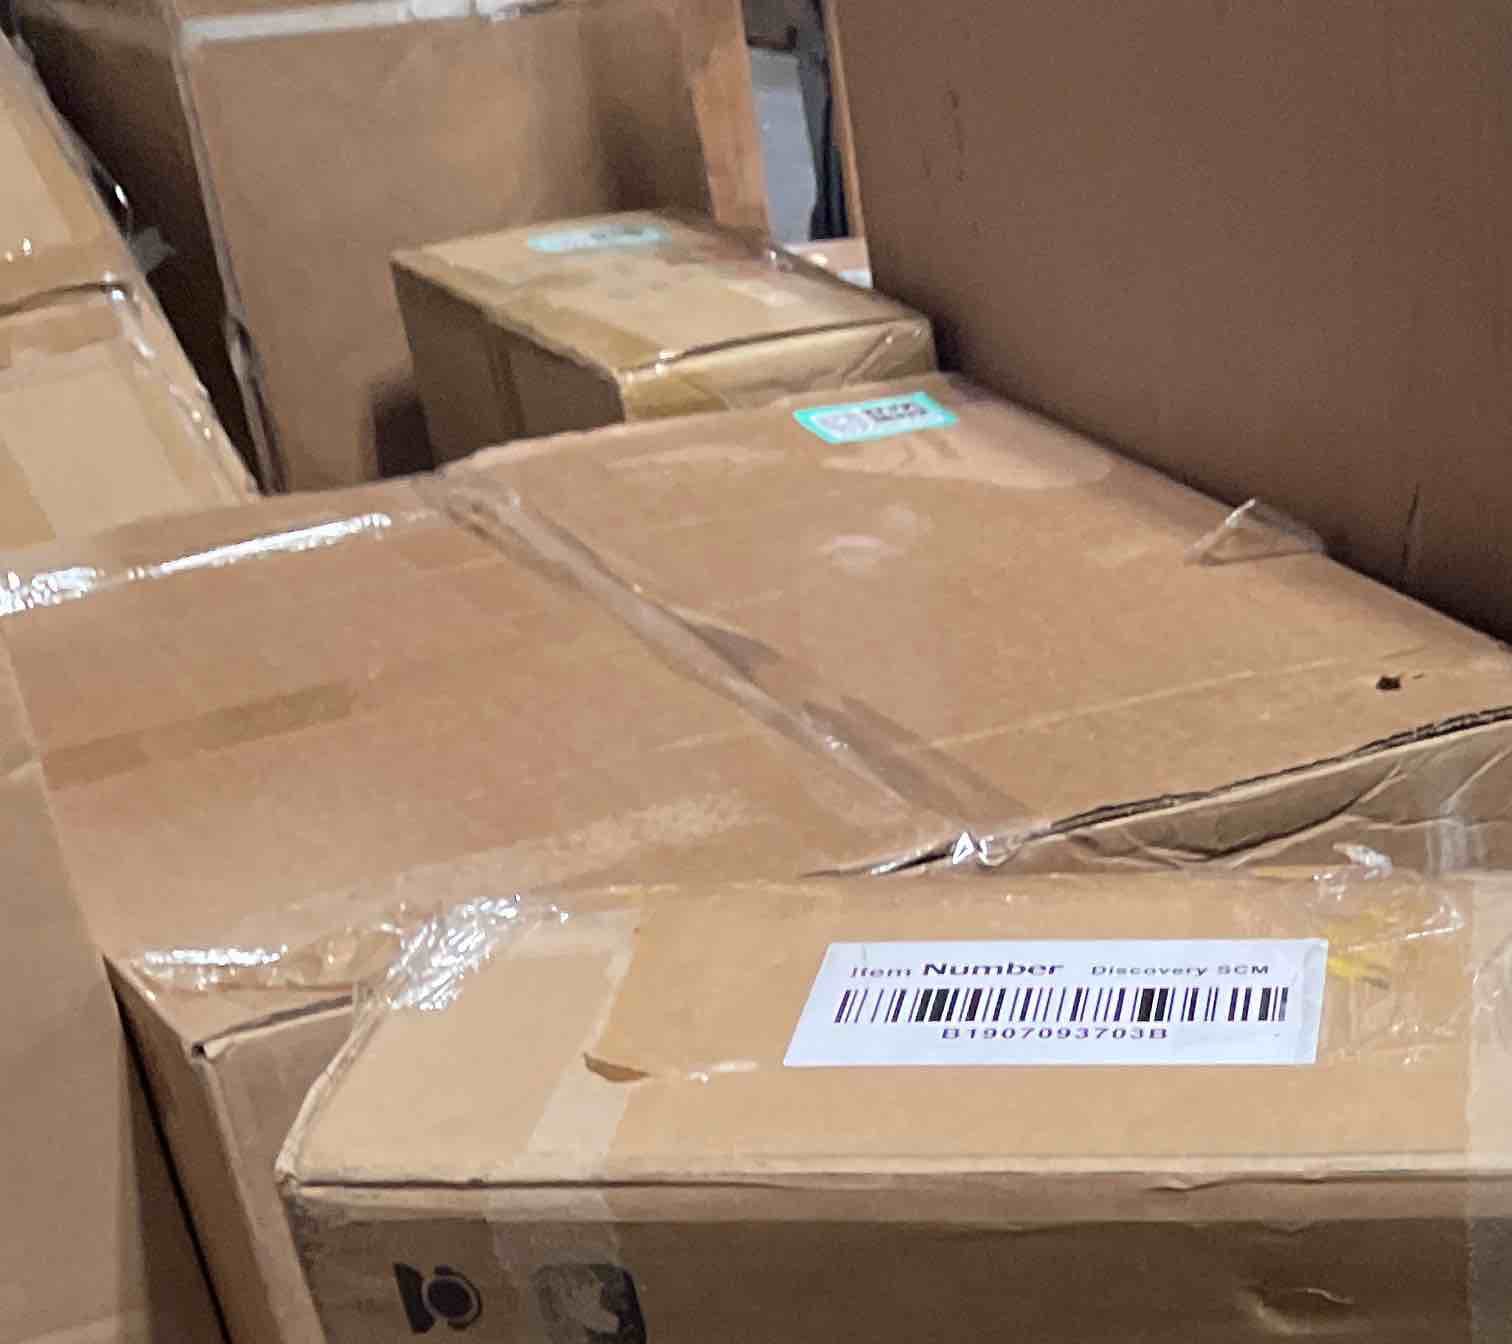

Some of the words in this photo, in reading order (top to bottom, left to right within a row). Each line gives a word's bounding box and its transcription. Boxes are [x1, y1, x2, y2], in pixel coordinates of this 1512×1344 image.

[848, 967, 912, 979] Item
[922, 961, 1065, 977] Number
[1091, 964, 1209, 977] Discovery
[1217, 964, 1271, 975] SCM
[941, 1027, 1169, 1040] B1907093703B
